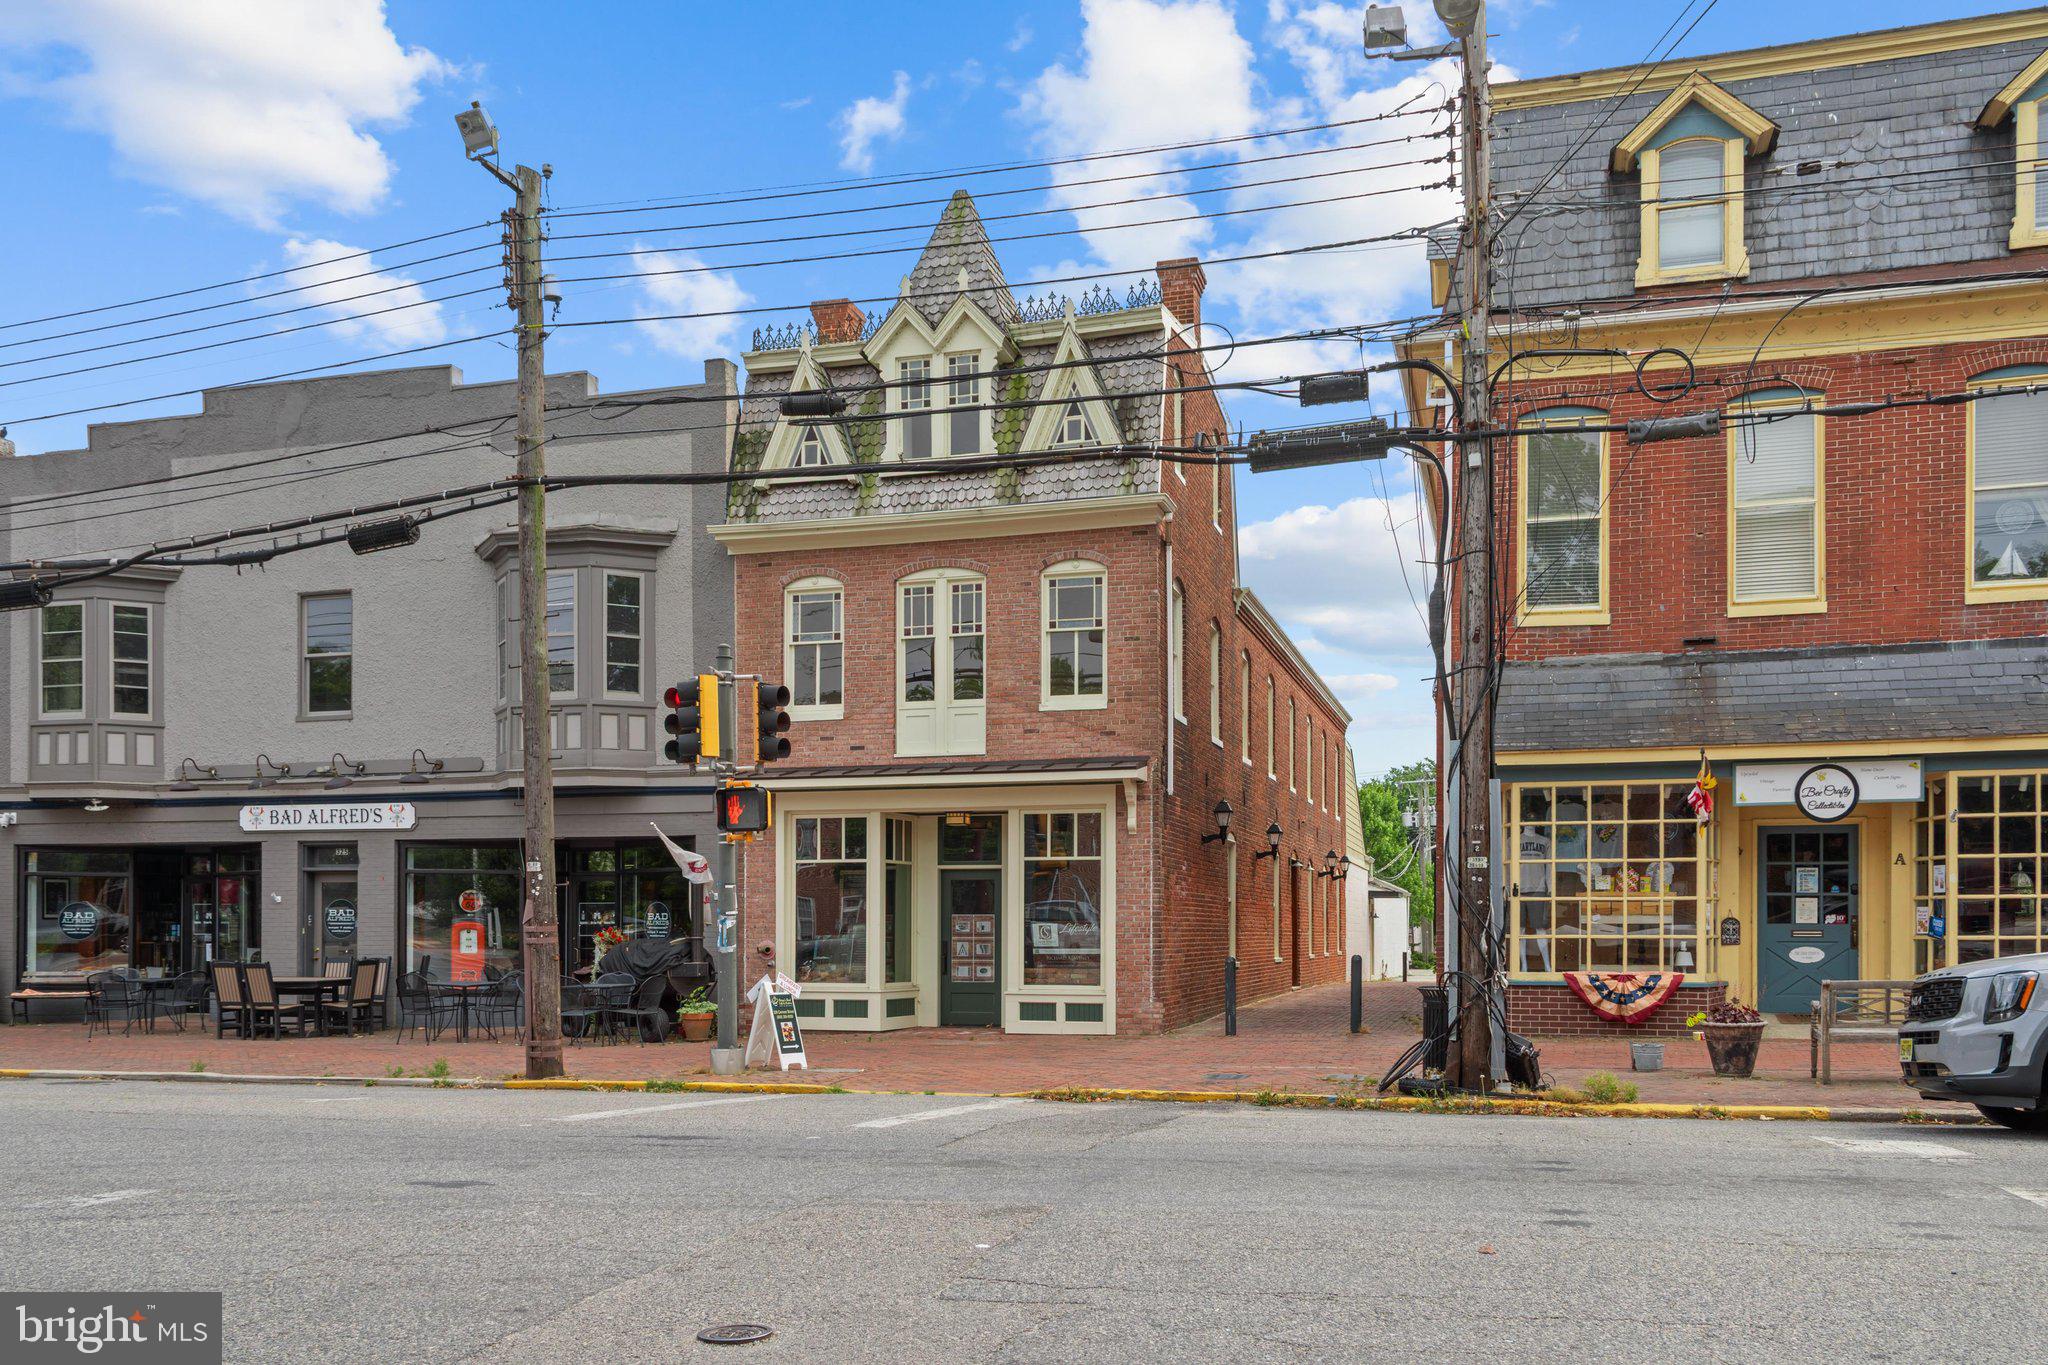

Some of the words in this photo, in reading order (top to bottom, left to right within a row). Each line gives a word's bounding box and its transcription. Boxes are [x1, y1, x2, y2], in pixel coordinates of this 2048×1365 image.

[1801, 787, 1822, 798] Bee
[1823, 785, 1852, 799] Crafty
[1807, 800, 1846, 811] Collectibles
[270, 809, 301, 825] BAD
[307, 808, 383, 825] ALFRED'S
[63, 911, 94, 919] BAD
[328, 909, 355, 917] BAD
[647, 912, 669, 920] BAD
